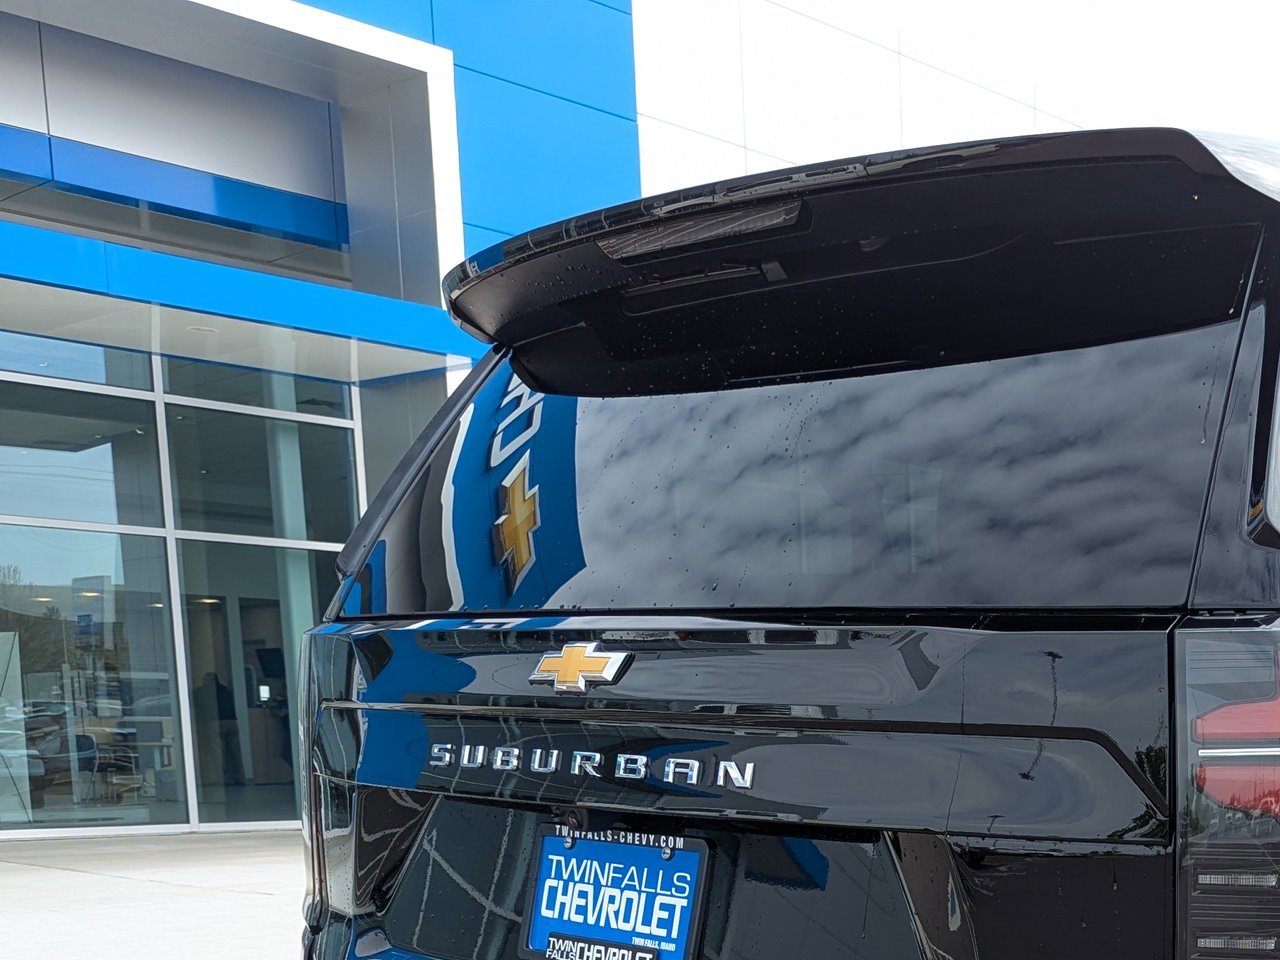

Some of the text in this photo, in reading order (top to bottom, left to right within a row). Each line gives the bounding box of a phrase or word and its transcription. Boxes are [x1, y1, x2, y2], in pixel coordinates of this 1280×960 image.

[429, 743, 756, 789] SUBURBAN
[540, 878, 688, 939] CHEVROLET
[548, 937, 578, 953] TWIN
